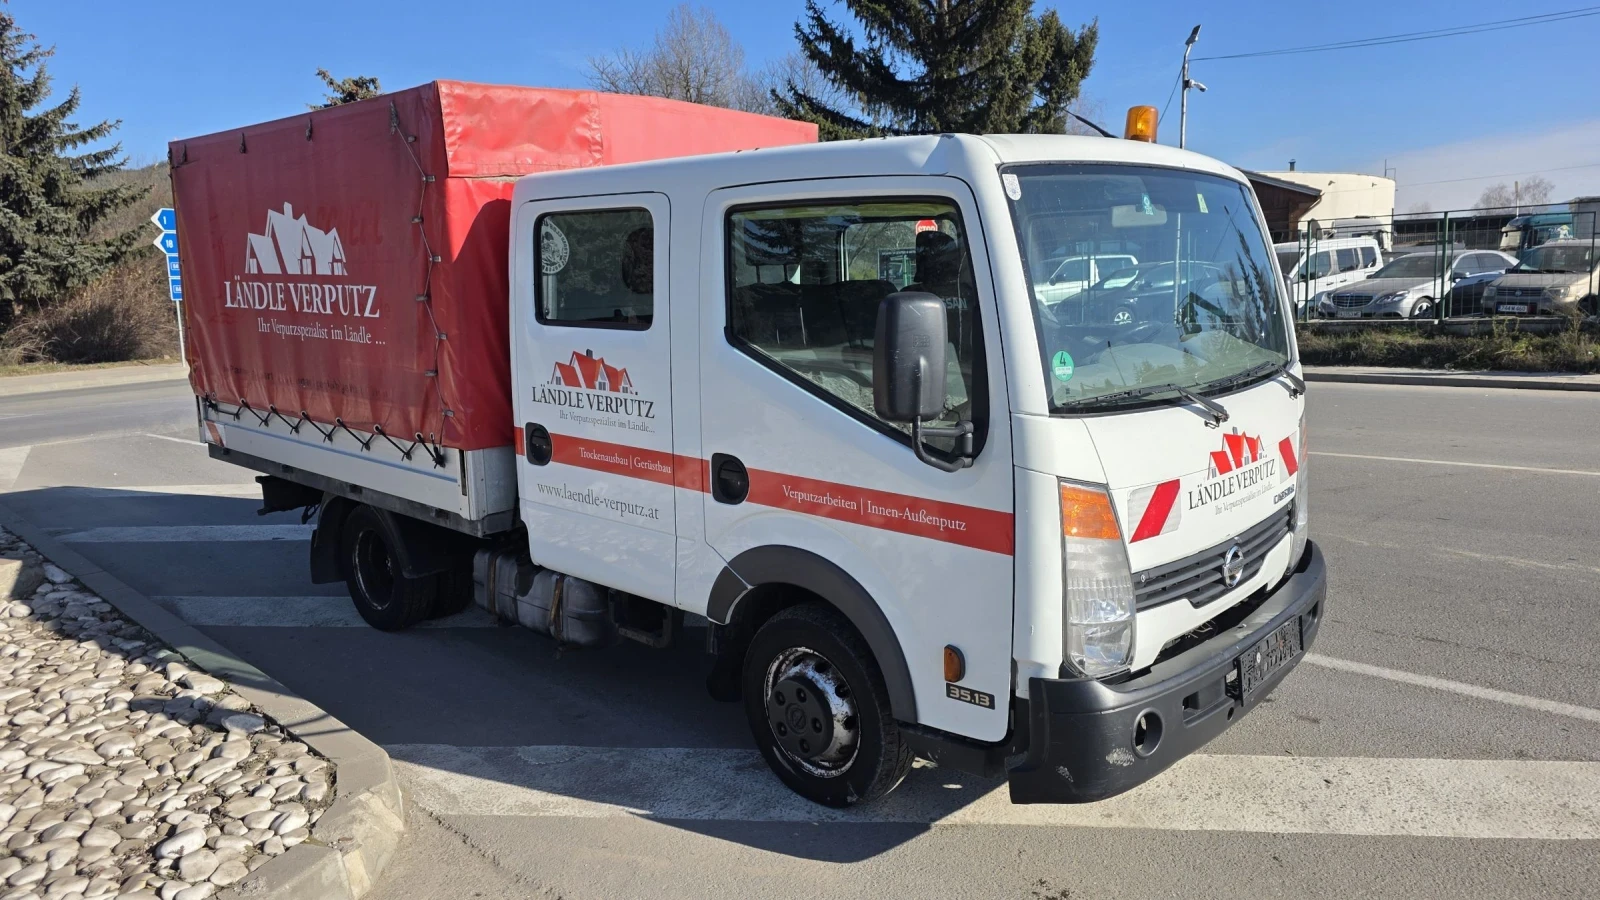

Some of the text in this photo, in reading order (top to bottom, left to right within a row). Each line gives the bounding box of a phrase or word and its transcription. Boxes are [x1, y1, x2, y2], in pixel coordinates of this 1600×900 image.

[163, 216, 167, 224] 1
[165, 240, 174, 248] 18
[224, 275, 380, 318] LÄNDLE VERPUTZ
[258, 317, 270, 333] Ihr
[271, 318, 328, 342] Verputzspezialist
[331, 324, 343, 340] im
[344, 324, 372, 344] Ländle
[1060, 351, 1067, 366] 4
[532, 383, 656, 419] LÄNDLE VERPUTZ
[559, 410, 569, 421] Ihr
[569, 411, 617, 428] Verputzspezialist
[617, 420, 627, 429] im
[579, 447, 629, 466] Trockenausbau
[633, 456, 672, 474] Gerüstbau
[1188, 458, 1276, 511] LÄNDLE VERPUTZ
[537, 483, 659, 520] www.laendle-verputz.at
[782, 484, 857, 511] Verputzarbeiten
[867, 500, 967, 531] Innen-Außenputz
[949, 686, 990, 707] 35.13
